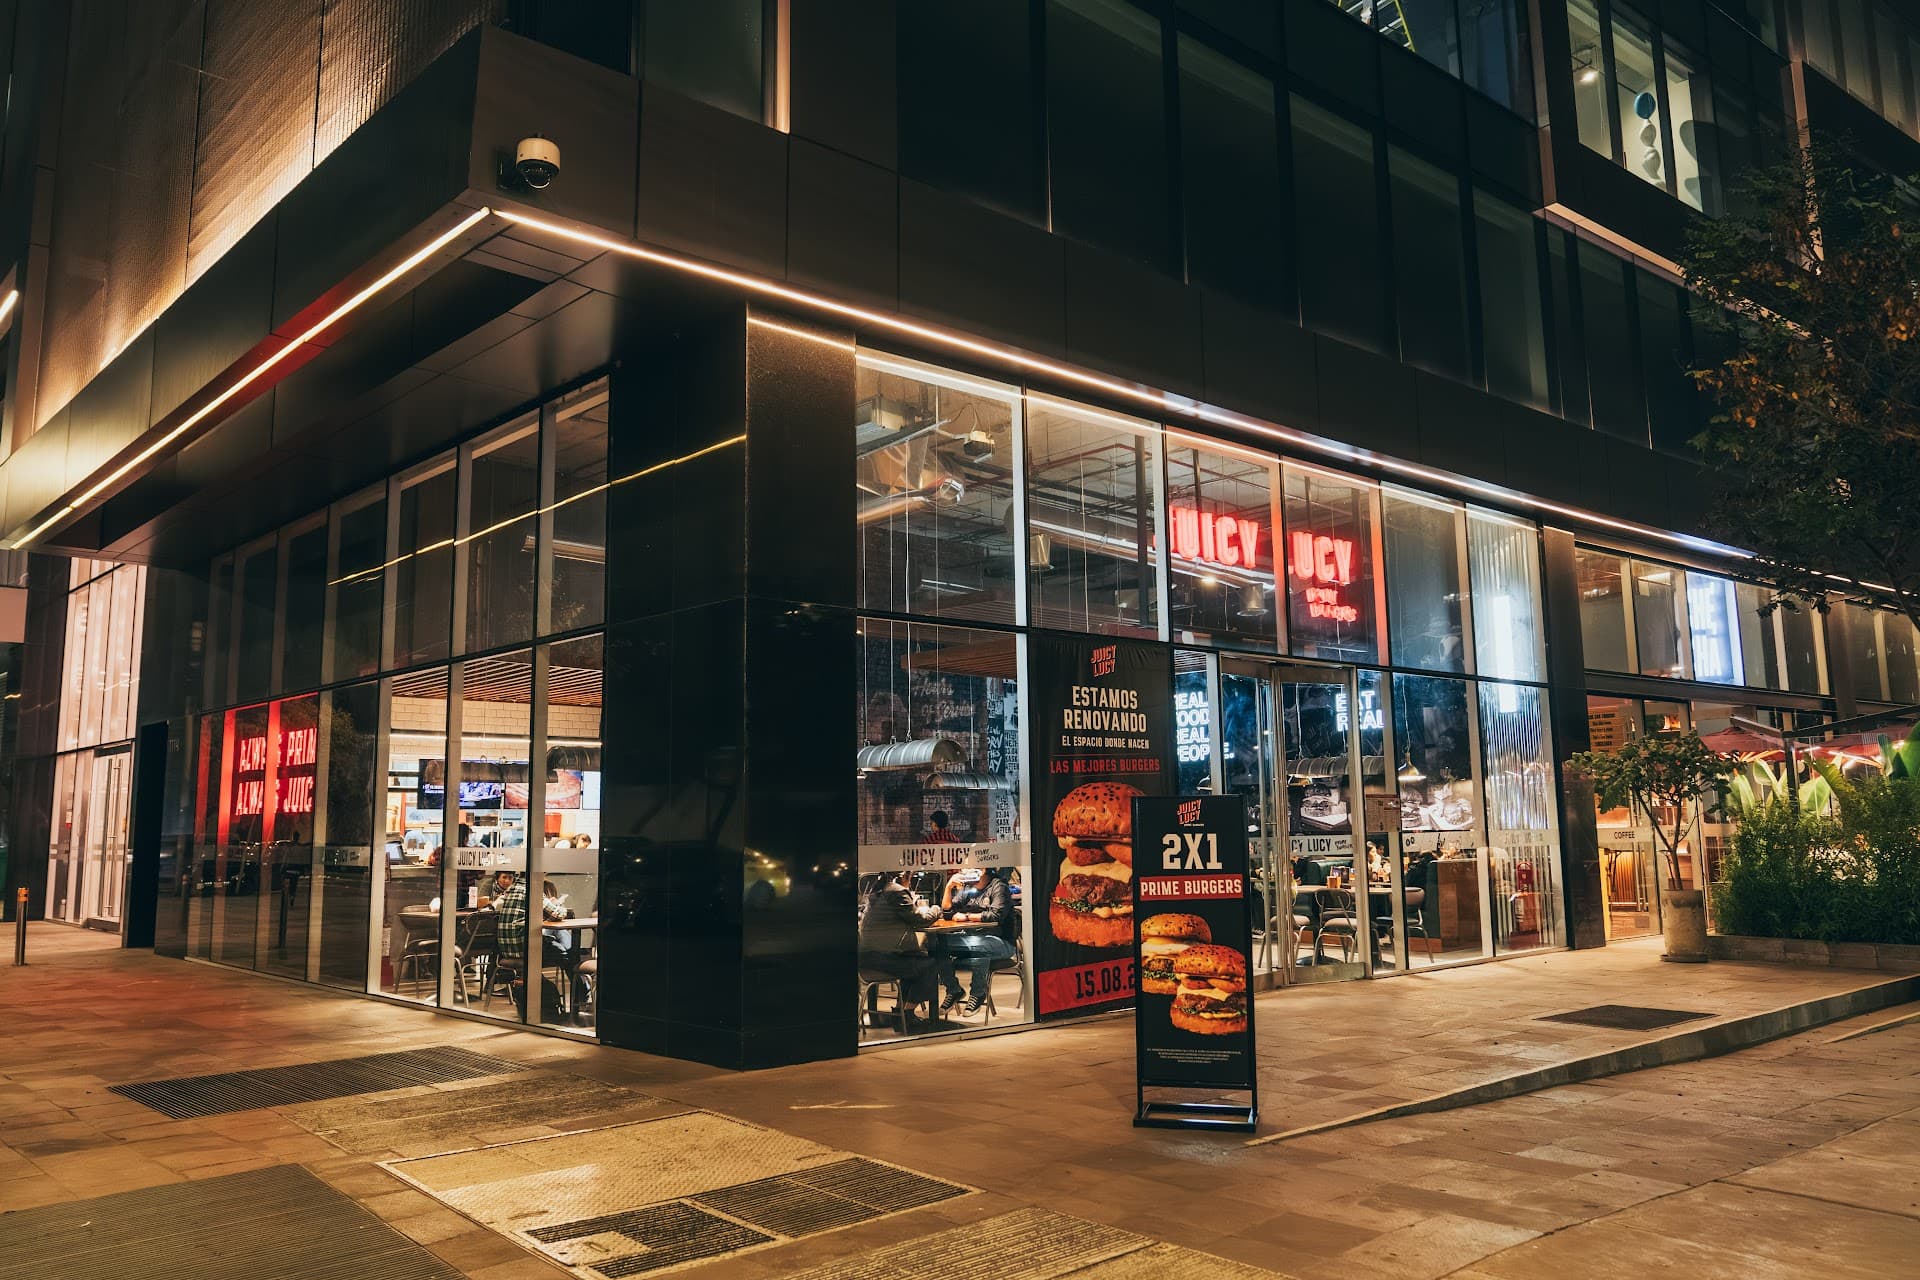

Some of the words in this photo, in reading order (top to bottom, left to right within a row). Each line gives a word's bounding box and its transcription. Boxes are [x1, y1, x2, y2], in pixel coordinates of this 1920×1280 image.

[1288, 531, 1353, 585] UCY
[1090, 645, 1117, 664] JUICY
[1093, 659, 1116, 677] LUCY
[1071, 685, 1138, 710] ESTAMOS
[1174, 691, 1209, 710] EAL
[1335, 690, 1375, 712] ET
[1063, 708, 1147, 733] RENOVANDO
[1175, 708, 1210, 727] OOD
[1336, 709, 1385, 732] RAL
[1061, 735, 1072, 747] EL
[1073, 735, 1103, 748] ESPACIO
[1104, 736, 1126, 749] DONDE
[1128, 737, 1150, 750] NACEN
[1176, 726, 1210, 745] EAL
[286, 727, 318, 767] PRIM
[1049, 760, 1070, 774] LAS
[1072, 759, 1117, 773] MEJORES
[1119, 758, 1160, 772] BURGERS
[283, 776, 314, 813] JUIC
[1177, 799, 1202, 815] JUICY
[1178, 810, 1201, 825] LUCY
[1614, 830, 1636, 840] COFFEE
[1162, 833, 1223, 870] 2X1
[1307, 838, 1332, 852] LUCY
[457, 850, 477, 866] JUICY
[899, 848, 935, 866] JUICY
[941, 847, 970, 865] LUCY
[1141, 881, 1181, 897] PRIME
[1184, 878, 1243, 896] BURGERS
[1075, 963, 1136, 999] 15.08.2
